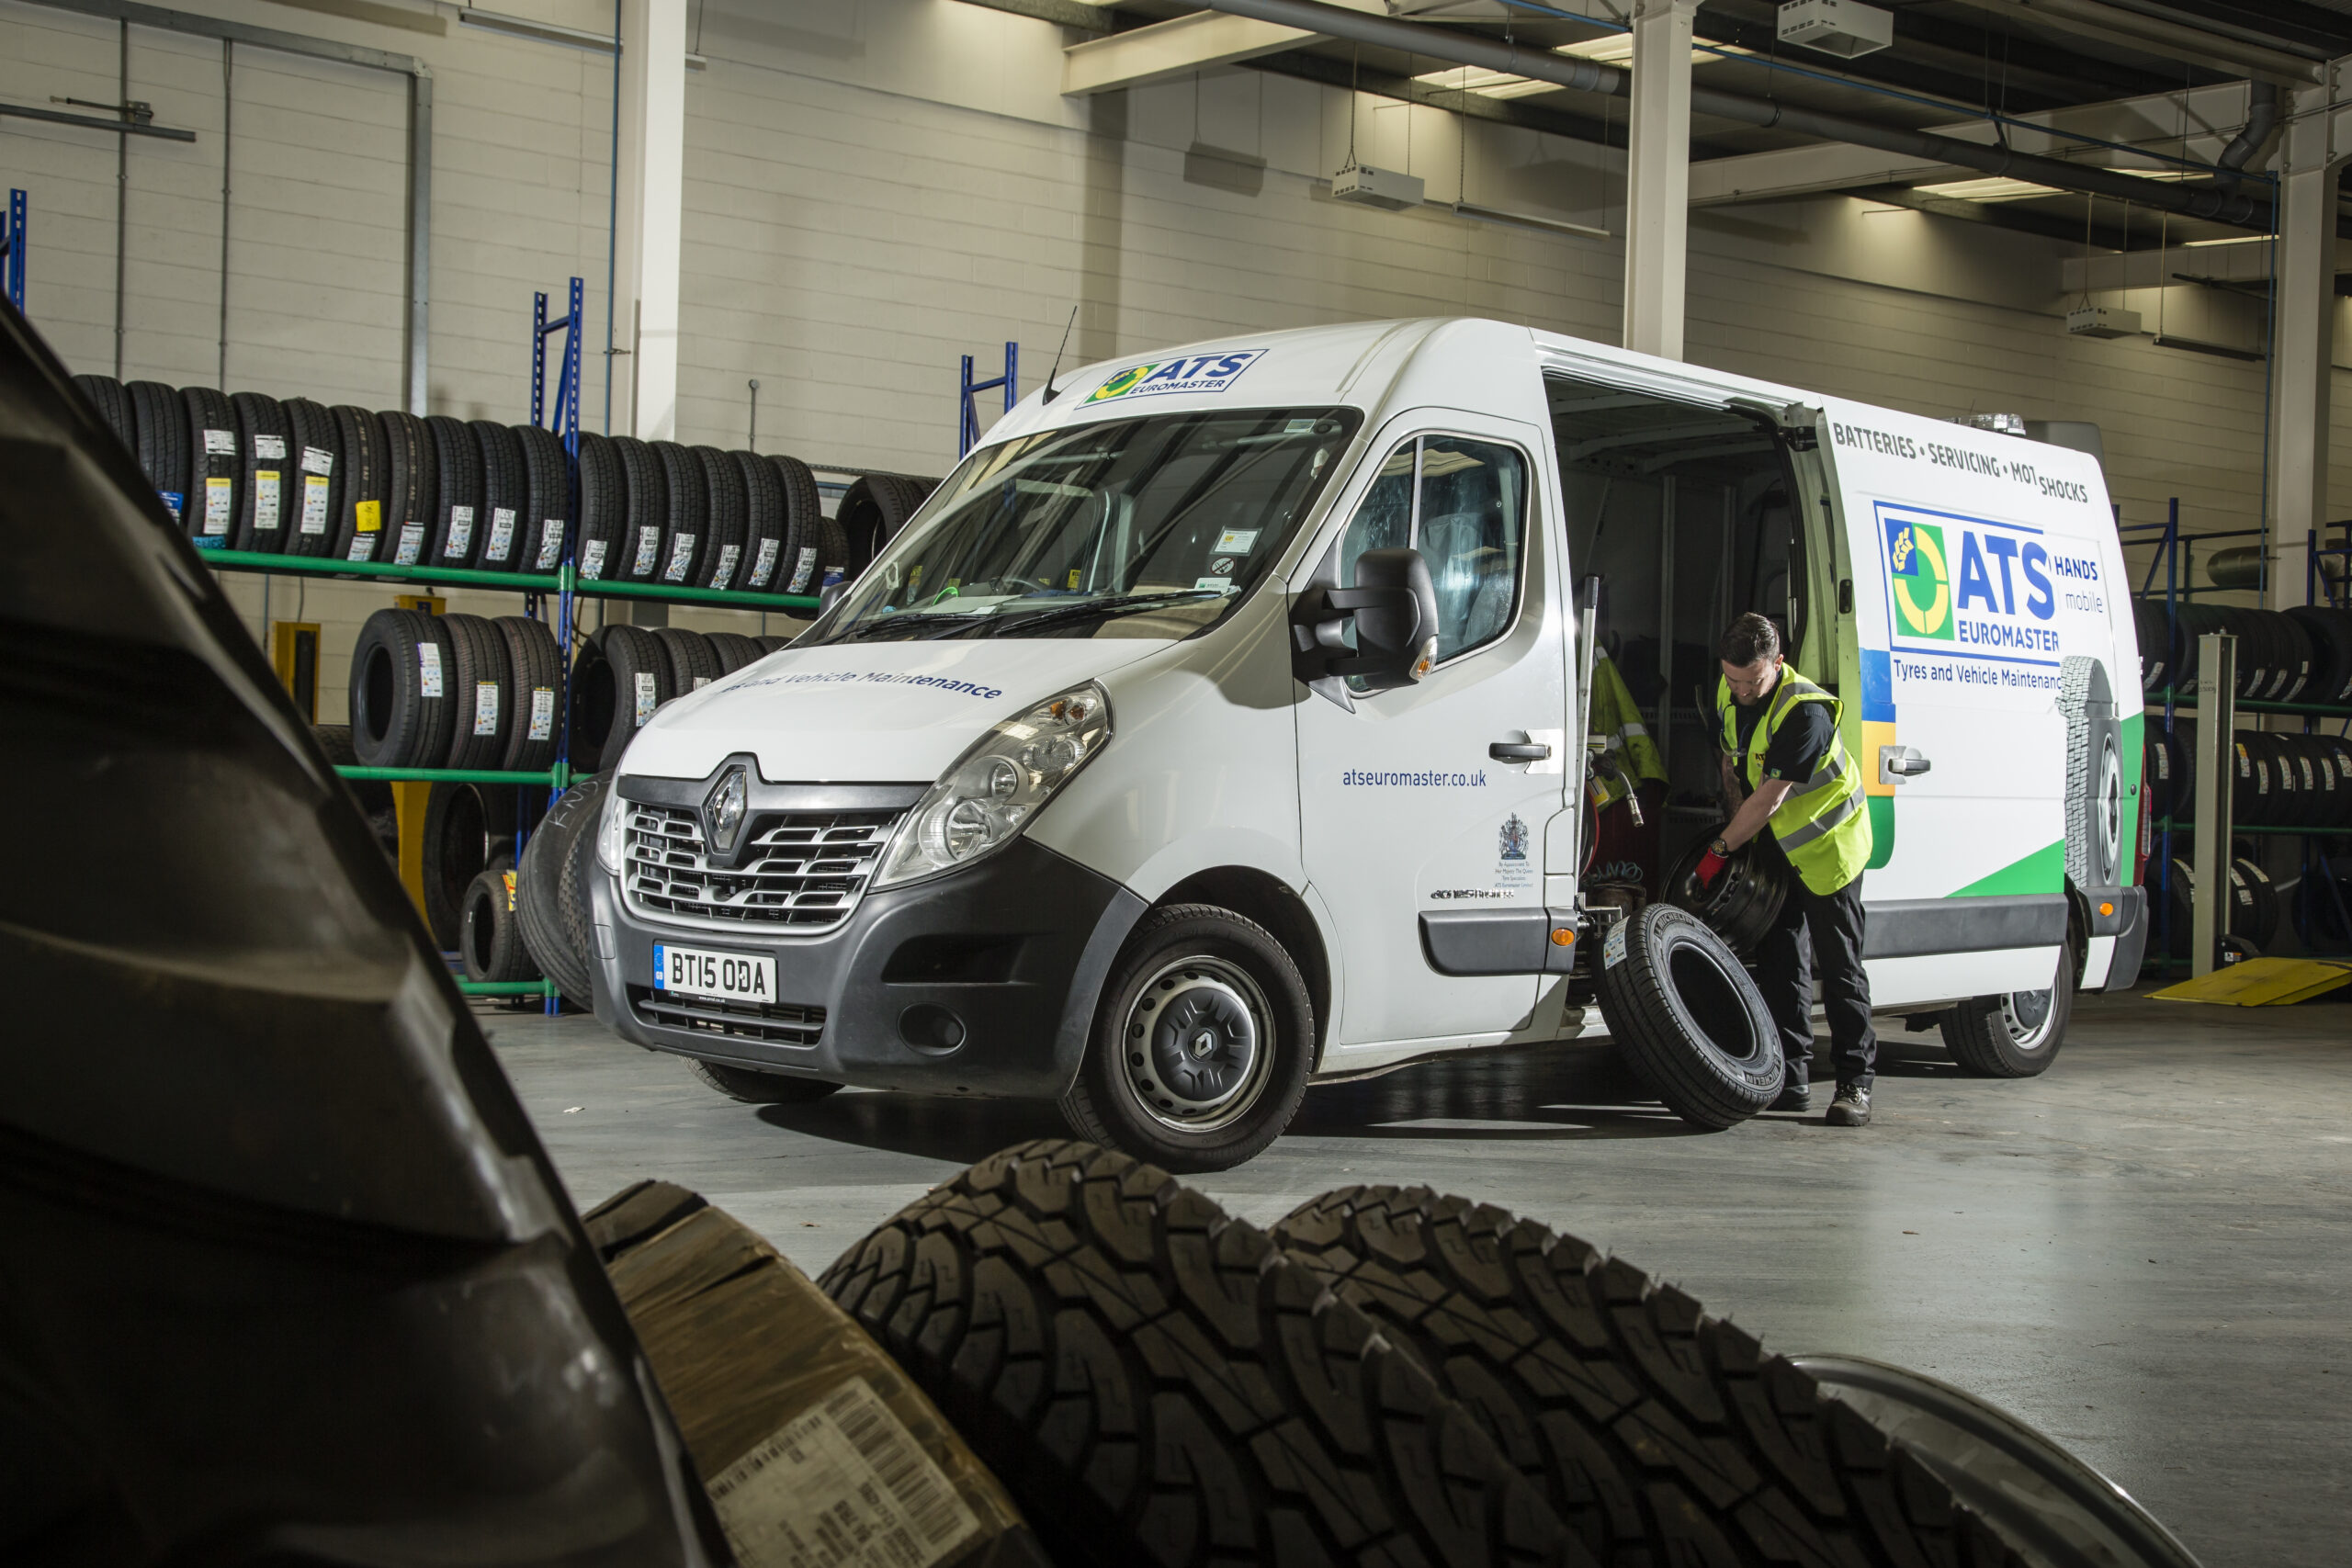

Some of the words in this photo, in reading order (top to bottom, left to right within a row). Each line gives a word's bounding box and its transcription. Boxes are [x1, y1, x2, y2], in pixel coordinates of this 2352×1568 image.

[1142, 354, 1253, 383] ATS
[1130, 379, 1225, 394] EUROMASTER
[1833, 423, 1916, 459] BATTERIES
[1928, 443, 2000, 477] SERVICING
[2039, 476, 2088, 503] SHOCKS
[1958, 530, 2055, 620] ATS
[2054, 556, 2098, 581] HANDS
[2065, 591, 2103, 613] mobile
[1959, 620, 2059, 651] EUROMASTER
[785, 672, 856, 683] Vehicle
[857, 671, 1002, 700] Maintenance
[1894, 660, 1927, 682] Tyres
[1931, 664, 1952, 682] and
[1956, 664, 1997, 685] Vehicle
[2001, 669, 2061, 690] Maintenanc
[1342, 768, 1487, 786] atseuromaster.co.uk
[1657, 912, 1694, 929] MICHELIN
[672, 953, 717, 989] BT15
[1746, 1065, 1781, 1085] MICHELIN
